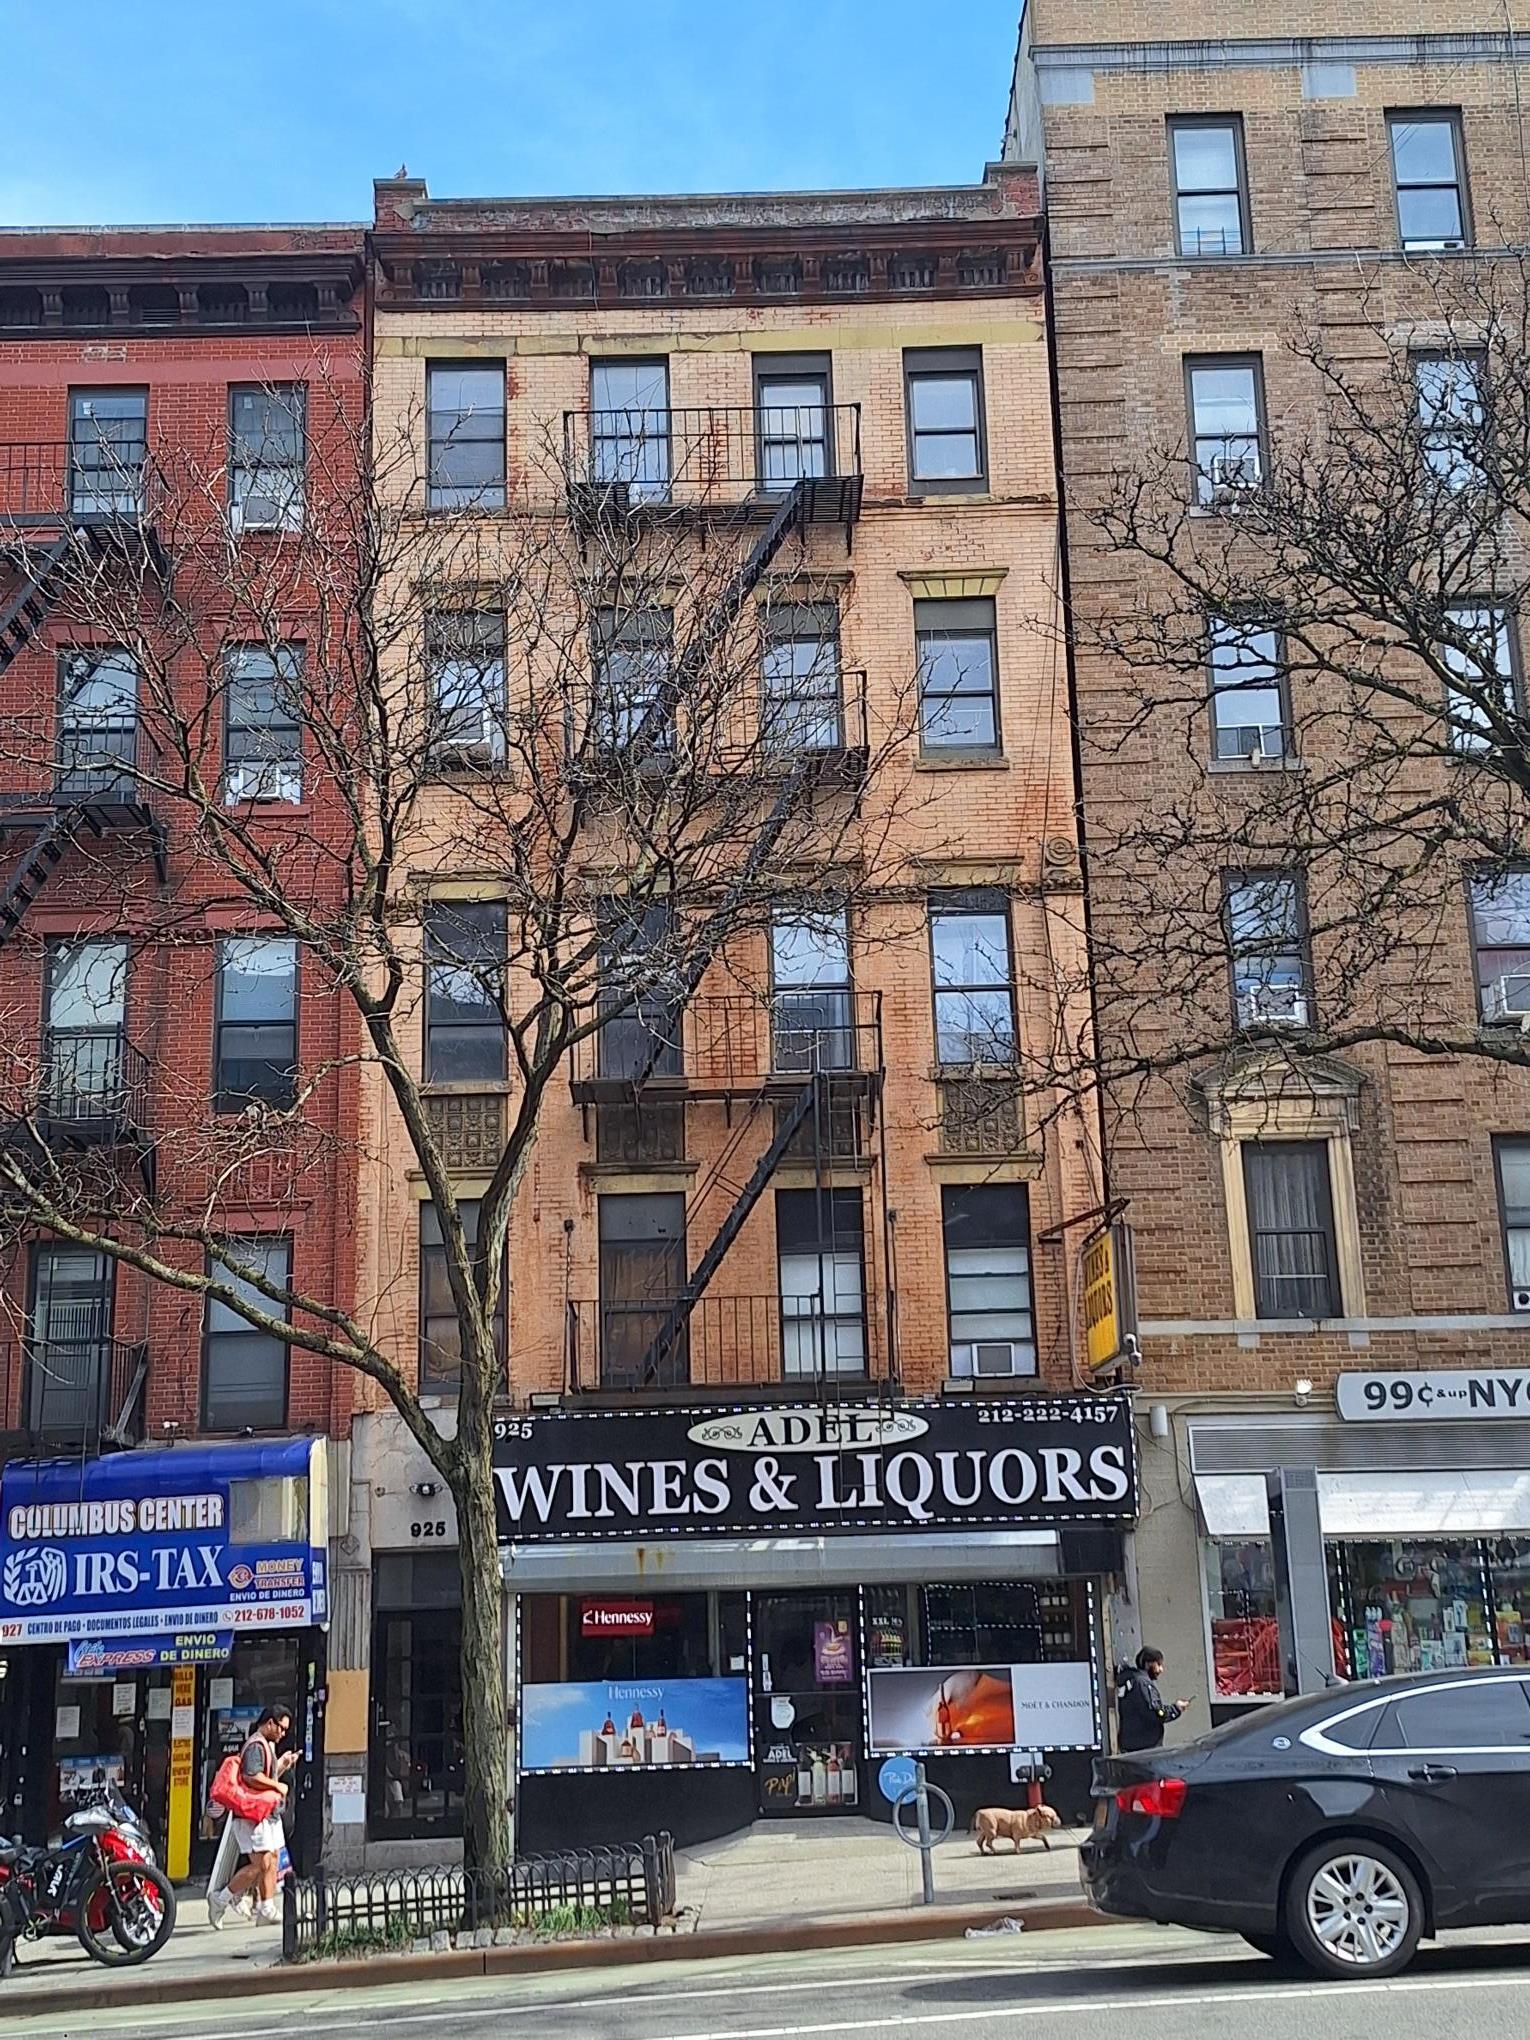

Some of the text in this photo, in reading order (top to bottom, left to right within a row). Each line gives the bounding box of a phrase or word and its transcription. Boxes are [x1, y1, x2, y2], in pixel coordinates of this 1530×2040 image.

[1363, 1380, 1434, 1410] 99¢
[1468, 1378, 1530, 1408] NY
[978, 1405, 1118, 1424] 212-222-4157
[494, 1421, 533, 1440] 925
[747, 1413, 877, 1447] ADEL
[493, 1444, 1129, 1524] WINES & LIQUORS
[8, 1494, 225, 1540] COLUMBUS CENTER
[410, 1521, 446, 1537] 925
[73, 1545, 225, 1596] IRS-TAX
[255, 1557, 305, 1574] MONEY
[254, 1575, 306, 1590] TRANSFER
[229, 1588, 305, 1602] ENVIO DE DINERO
[27, 1611, 218, 1635] CENTRO DE PAGO DOCUMENTOS LEGALES ENVIO DE DINERO
[234, 1605, 305, 1623] 212-678-1052
[594, 1609, 653, 1626] Hennessy
[2, 1623, 23, 1637] 927
[175, 1633, 216, 1647] ENVIO
[76, 1647, 230, 1668] EXPRESS DE DINERO
[608, 1685, 665, 1700] Hennessy
[768, 1749, 793, 1760] ADEL
